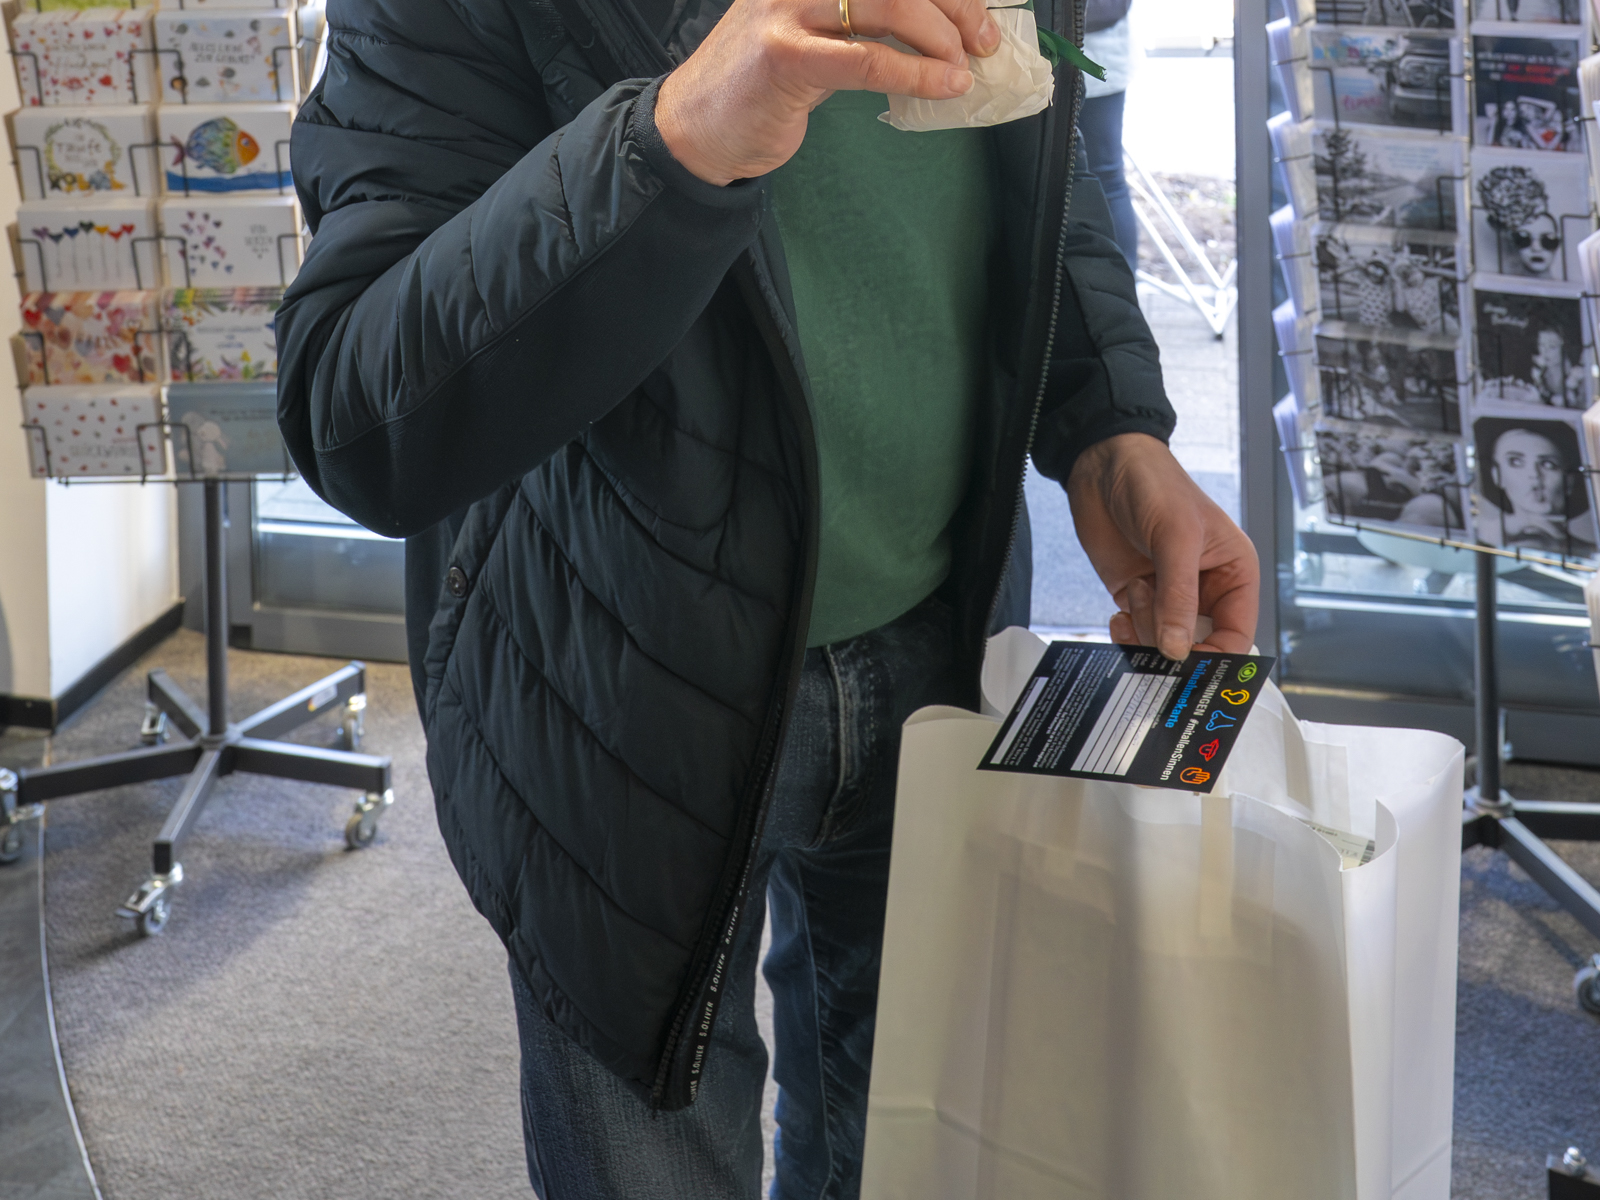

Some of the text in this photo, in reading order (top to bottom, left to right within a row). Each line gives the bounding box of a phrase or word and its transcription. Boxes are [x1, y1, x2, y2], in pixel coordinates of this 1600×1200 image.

[1164, 658, 1212, 729] Teilnahmekarte
[1192, 658, 1231, 717] LAUCHRINGEN
[1160, 718, 1199, 781] #mitallenSinnen
[710, 953, 726, 993] S.OLIVER
[699, 1001, 714, 1037] S.OLIVER
[691, 1044, 705, 1075] S.OLIVER
